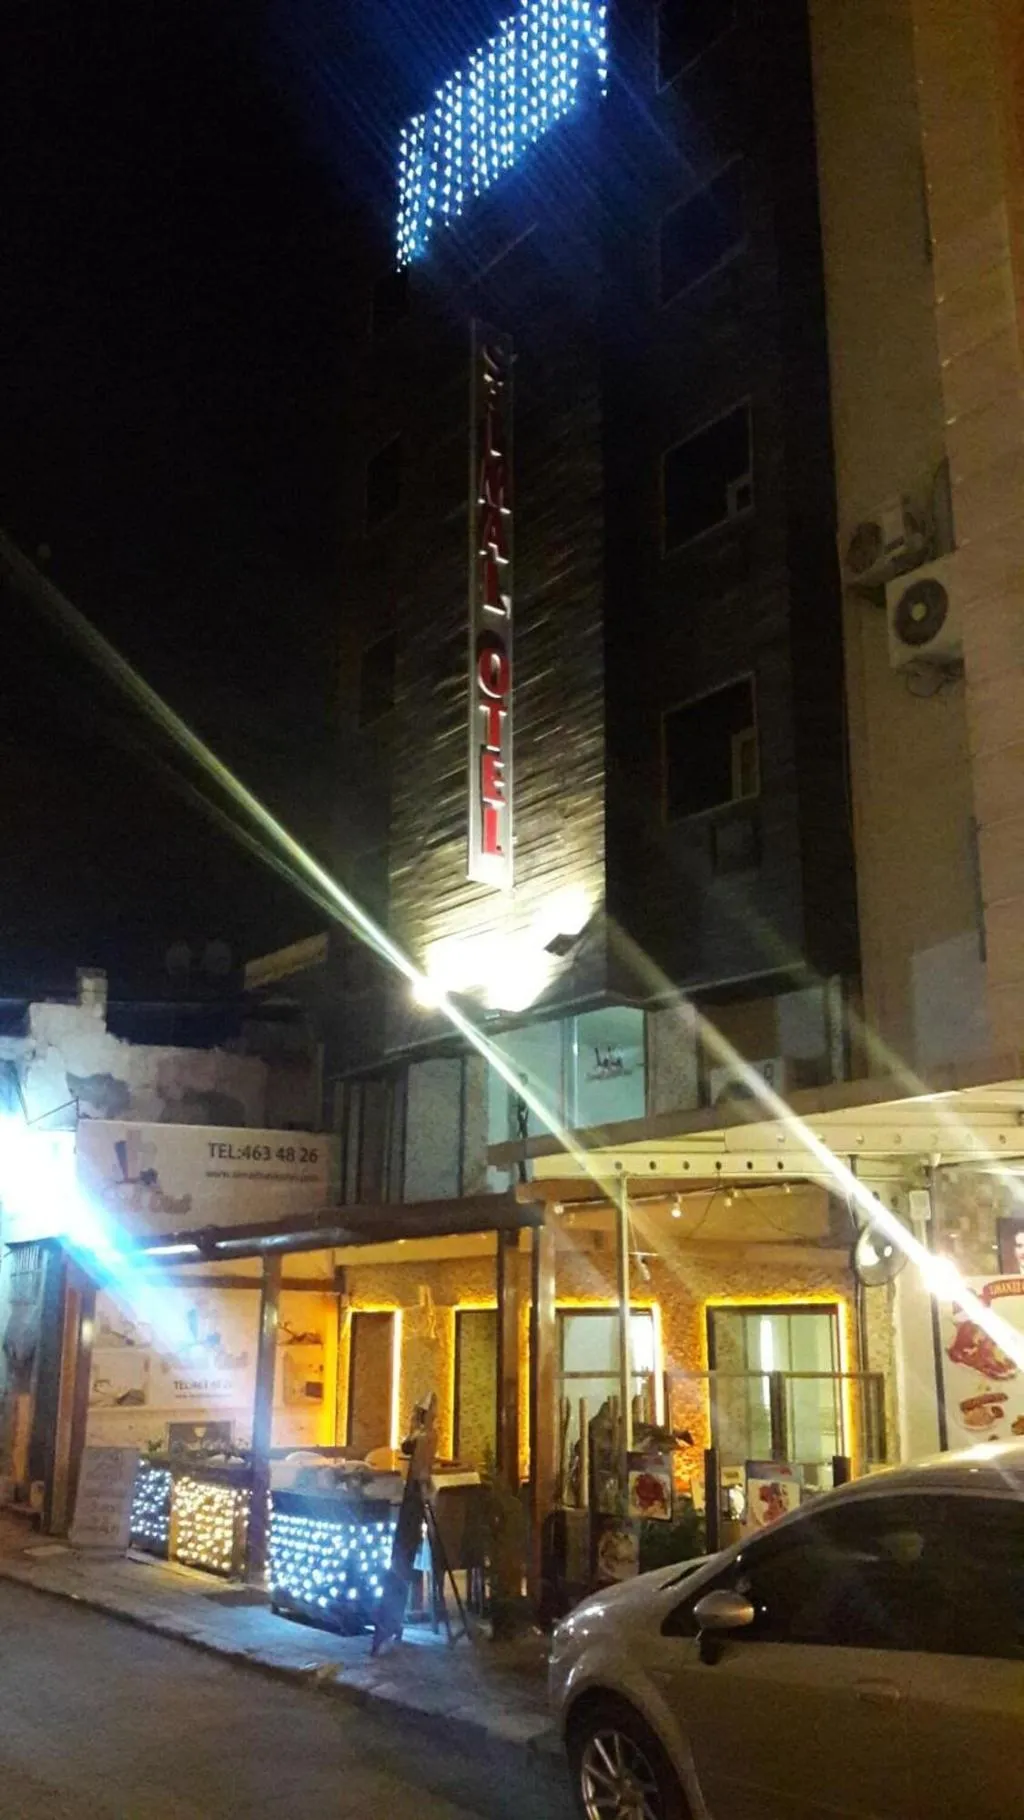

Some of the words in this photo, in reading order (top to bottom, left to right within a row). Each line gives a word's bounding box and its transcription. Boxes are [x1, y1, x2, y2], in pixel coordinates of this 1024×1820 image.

[476, 628, 511, 856] OTEL
[275, 1147, 296, 1163] 48
[299, 1147, 319, 1163] 26
